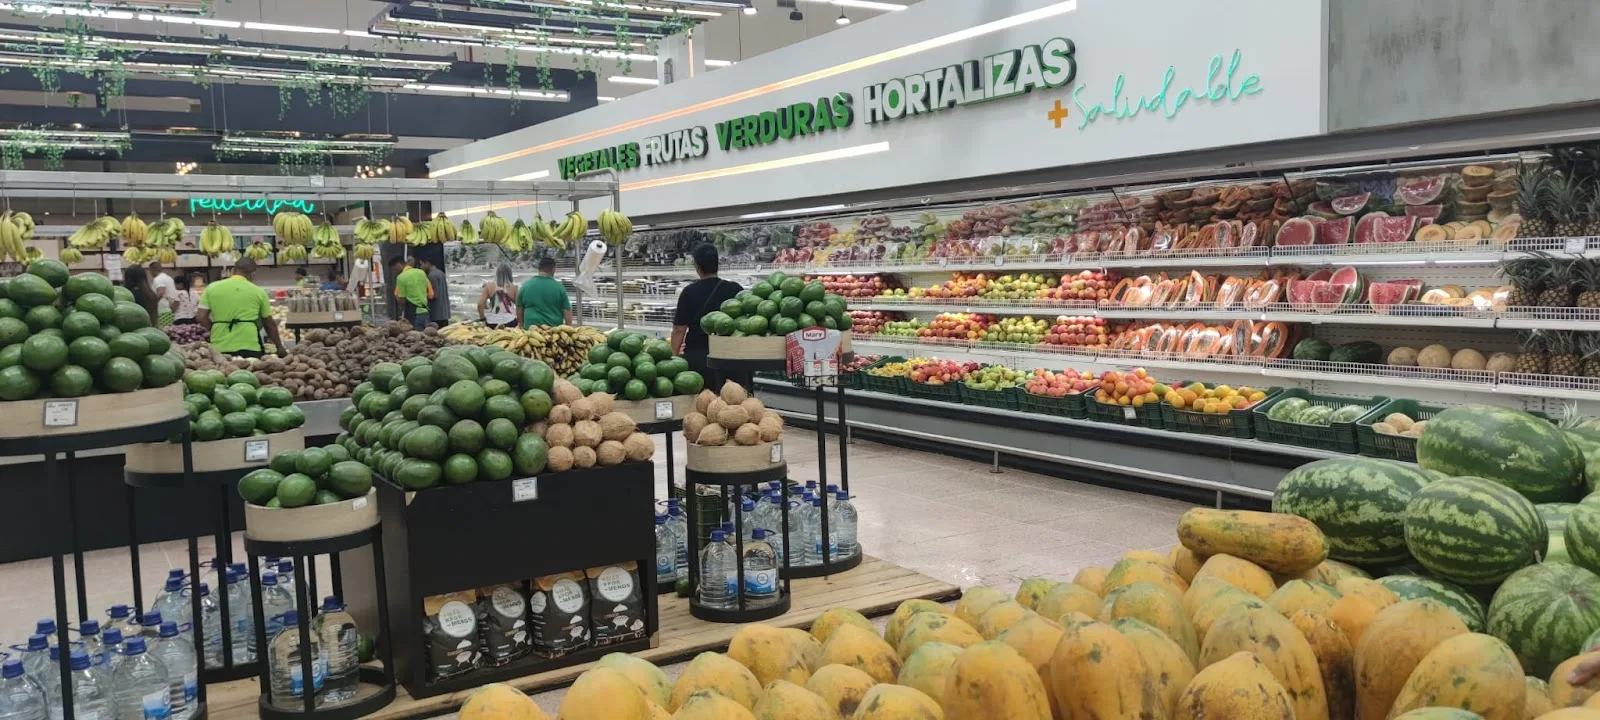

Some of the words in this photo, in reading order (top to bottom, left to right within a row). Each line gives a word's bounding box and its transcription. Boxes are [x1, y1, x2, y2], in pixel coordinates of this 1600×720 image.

[557, 142, 641, 181] VEGETALES
[642, 126, 708, 167] FRUTAS
[715, 92, 853, 152] VERDURAS
[863, 37, 1077, 125] HORTALIZAS
[1074, 49, 1263, 130] Saludable
